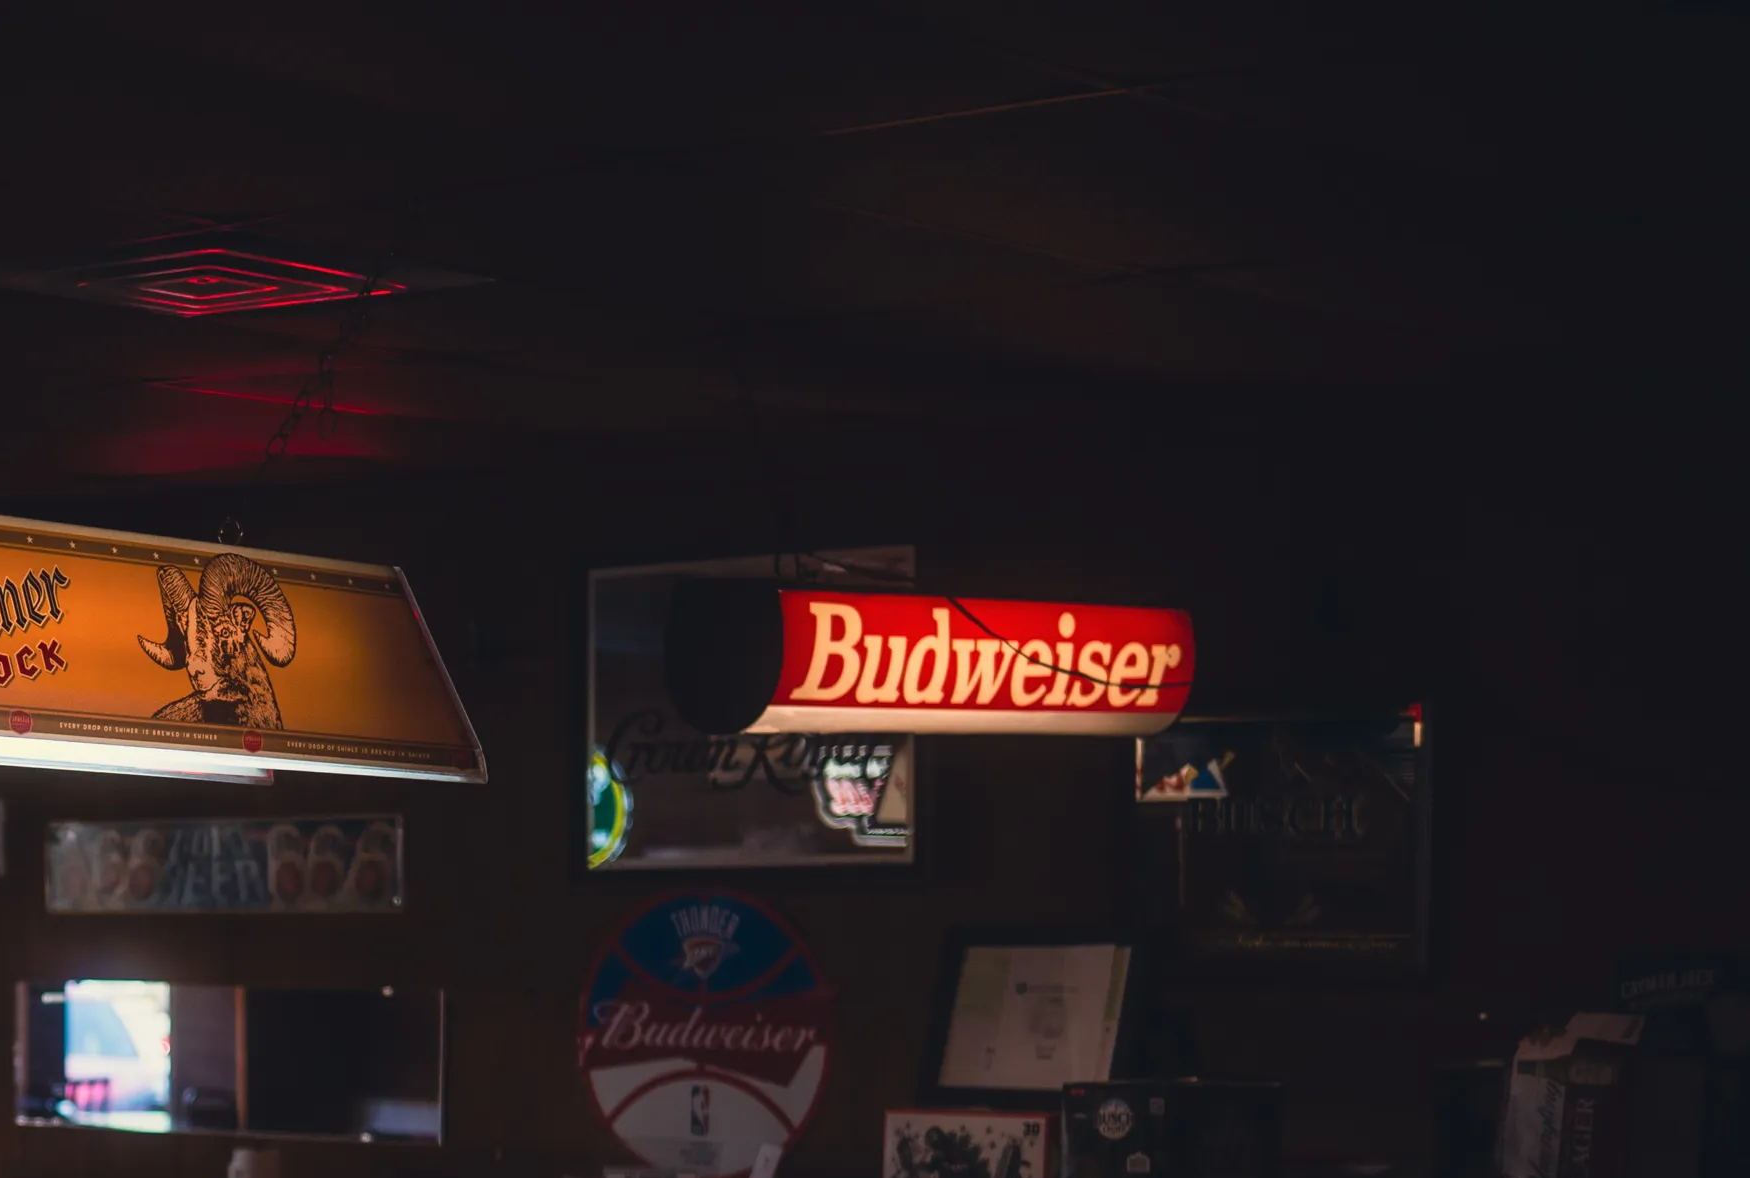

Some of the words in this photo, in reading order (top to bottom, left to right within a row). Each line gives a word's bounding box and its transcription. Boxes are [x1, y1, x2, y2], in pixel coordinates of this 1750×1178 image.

[788, 600, 1185, 708] Budweiser
[59, 722, 80, 730] EVERY
[115, 726, 139, 734] SHINER
[152, 729, 180, 738] BREWED
[193, 733, 218, 741] SHINER
[287, 740, 306, 748] EVERY
[607, 708, 740, 786] Crown
[669, 903, 740, 940] THUNDER
[593, 999, 818, 1053] Budweiser
[1023, 1120, 1040, 1137] 30
